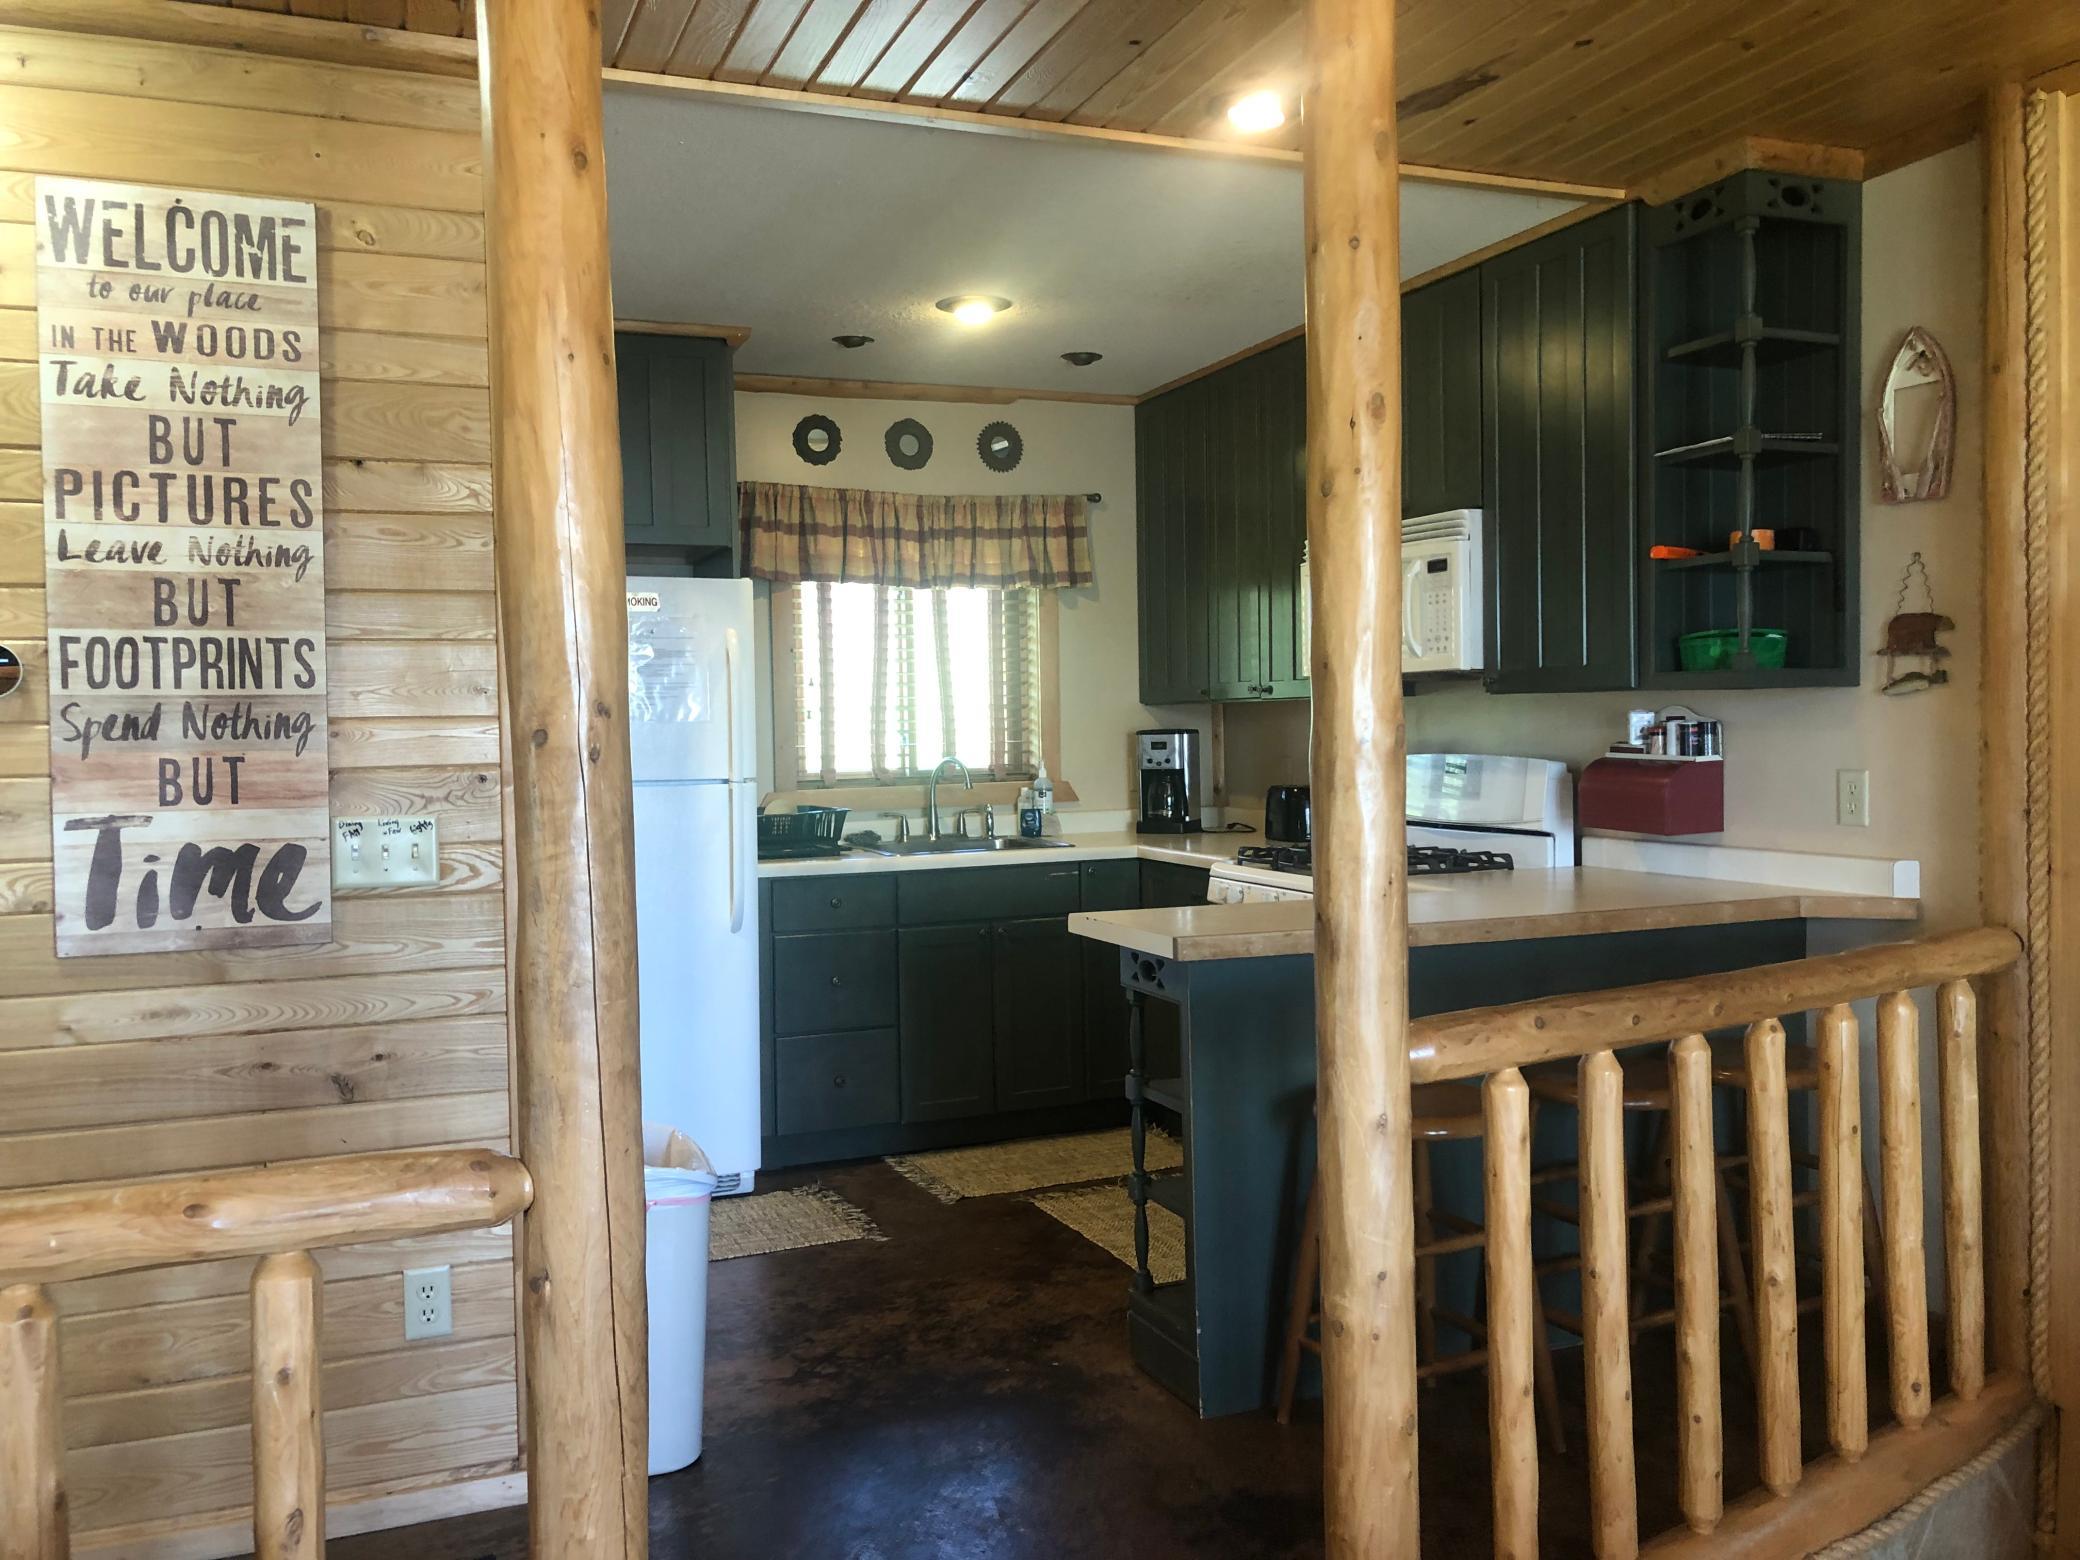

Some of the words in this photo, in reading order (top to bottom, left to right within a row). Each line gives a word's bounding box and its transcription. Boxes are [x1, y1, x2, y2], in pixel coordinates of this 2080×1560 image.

[45, 195, 307, 283] WELCOME
[88, 274, 112, 299] to
[129, 282, 173, 303] our
[188, 283, 261, 317] place
[52, 324, 75, 349] IN
[92, 327, 137, 352] THE
[151, 320, 302, 363] WOODS
[50, 360, 147, 401] Take
[169, 366, 311, 426] Nothing
[148, 414, 236, 467] BUT
[55, 468, 313, 528] PICTURES
[57, 528, 168, 564] Leave
[188, 534, 314, 583] Nothing
[154, 577, 241, 627] BUT
[59, 636, 316, 690] FOOTPRINTS
[60, 702, 161, 760] Spend
[182, 701, 316, 757] Nothing
[159, 756, 246, 807] BUT
[64, 815, 322, 931] Time
